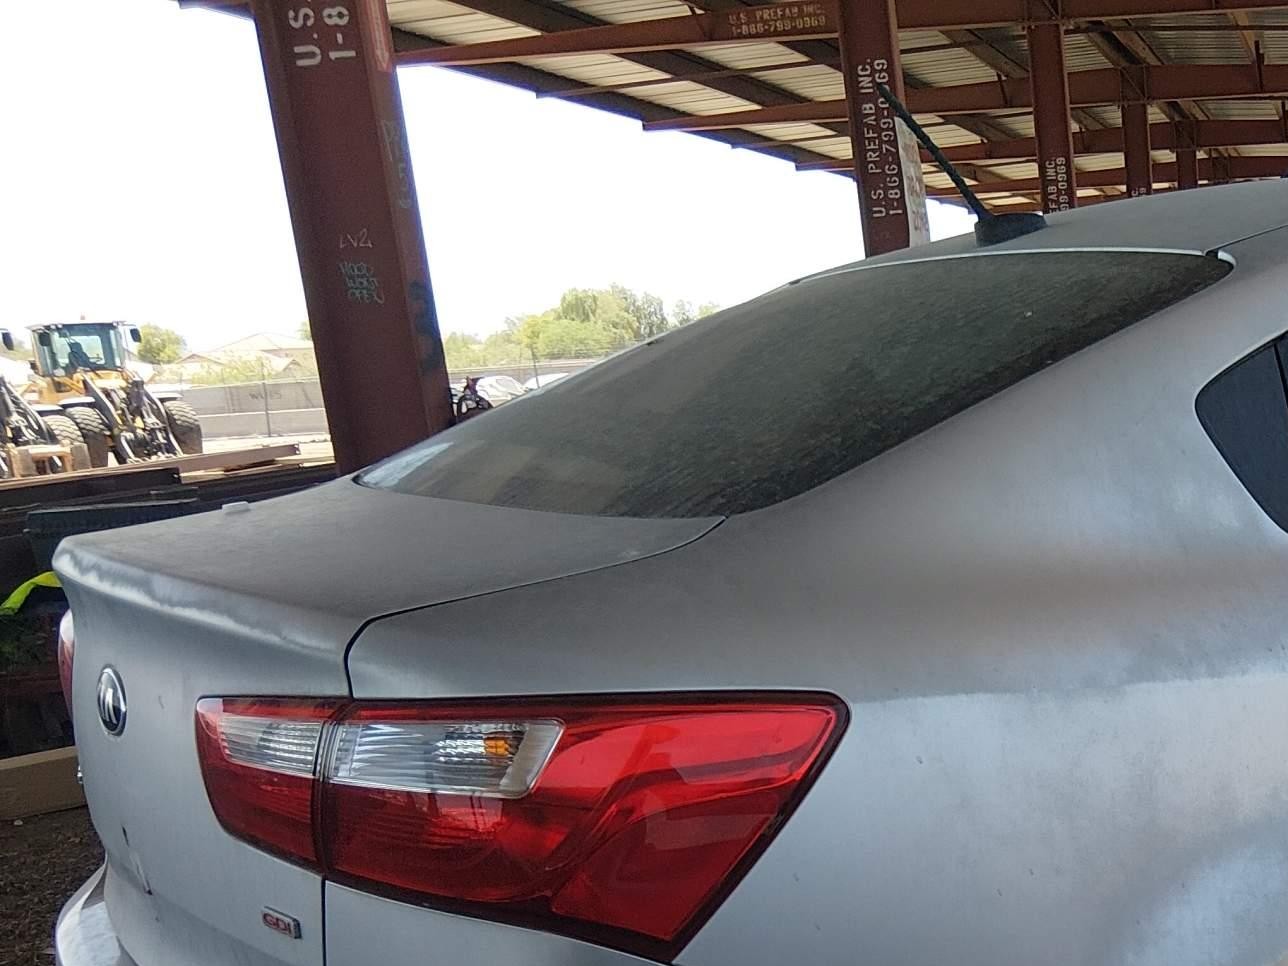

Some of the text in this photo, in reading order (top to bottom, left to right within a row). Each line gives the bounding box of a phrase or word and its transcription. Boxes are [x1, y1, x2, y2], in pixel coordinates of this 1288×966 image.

[857, 59, 886, 217] U.S. PREFAB INC.
